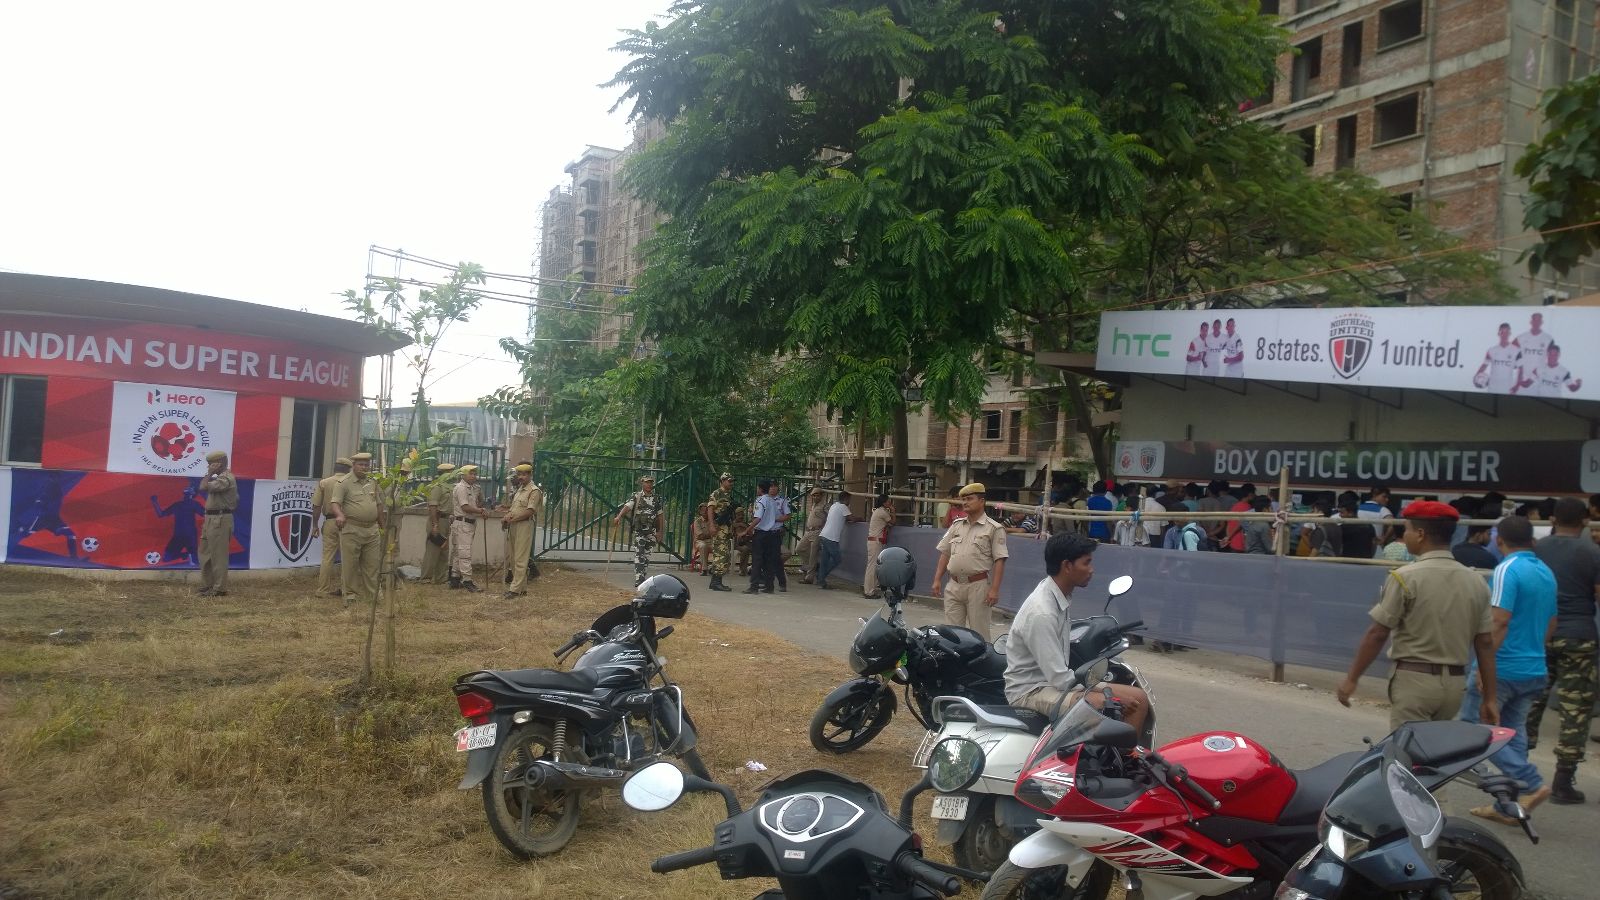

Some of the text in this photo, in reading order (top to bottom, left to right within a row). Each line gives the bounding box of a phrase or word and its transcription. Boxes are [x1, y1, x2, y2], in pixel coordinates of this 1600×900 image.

[1330, 327, 1374, 337] UNITED
[2, 330, 350, 388] INDIAN SUPER LEAGUE
[1256, 337, 1323, 362] 8 states.
[1381, 339, 1464, 368] 1 united.
[132, 409, 210, 448] INDIAN SUPER LEAGUE
[1214, 449, 1500, 482] BOX OFFICE COUNTER
[271, 500, 315, 512] UNITE
